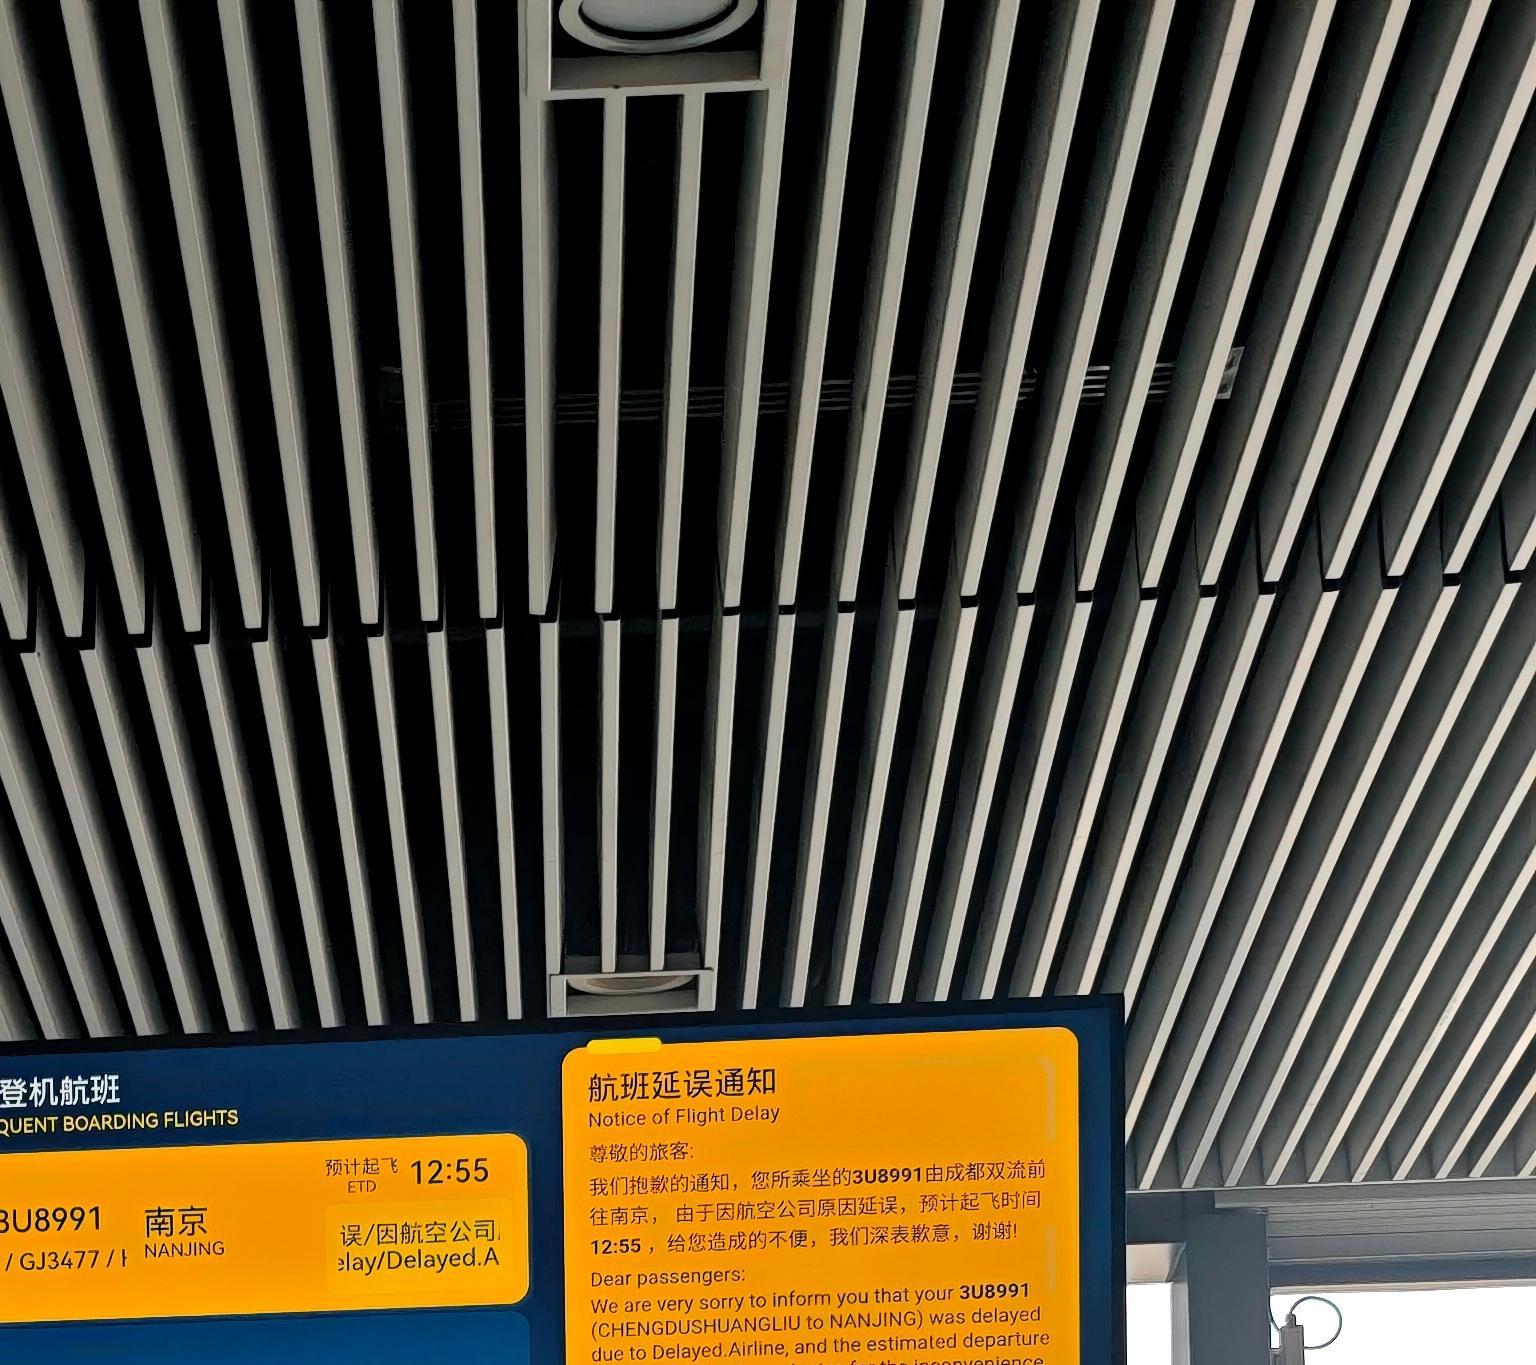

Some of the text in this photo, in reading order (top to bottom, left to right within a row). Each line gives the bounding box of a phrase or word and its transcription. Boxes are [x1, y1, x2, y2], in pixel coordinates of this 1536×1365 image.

[588, 1066, 776, 1103] 航班延误通知
[63, 1112, 159, 1132] BOARDING
[164, 1109, 239, 1128] FLIGHTS
[588, 1105, 780, 1128] Notice of Flight Delay
[325, 1157, 399, 1177] 预计起飞
[410, 1157, 490, 1185] 12:55
[347, 1179, 377, 1194] ETD
[144, 1205, 208, 1238] 南京
[340, 1219, 501, 1247] 误/因航空公司
[144, 1240, 225, 1259] NANJING
[590, 1238, 641, 1255] 12:55
[19, 1249, 100, 1271] GJ3477
[591, 1269, 745, 1289] Dear passengers:
[590, 1282, 1030, 1315] We are very sorry to inform you that your 3U8991
[591, 1305, 1041, 1342] (CHENGDUSHUANGLIU to NANJING) was delayed
[591, 1331, 1050, 1364] due to Delayed.Airline, and the estimated departure
